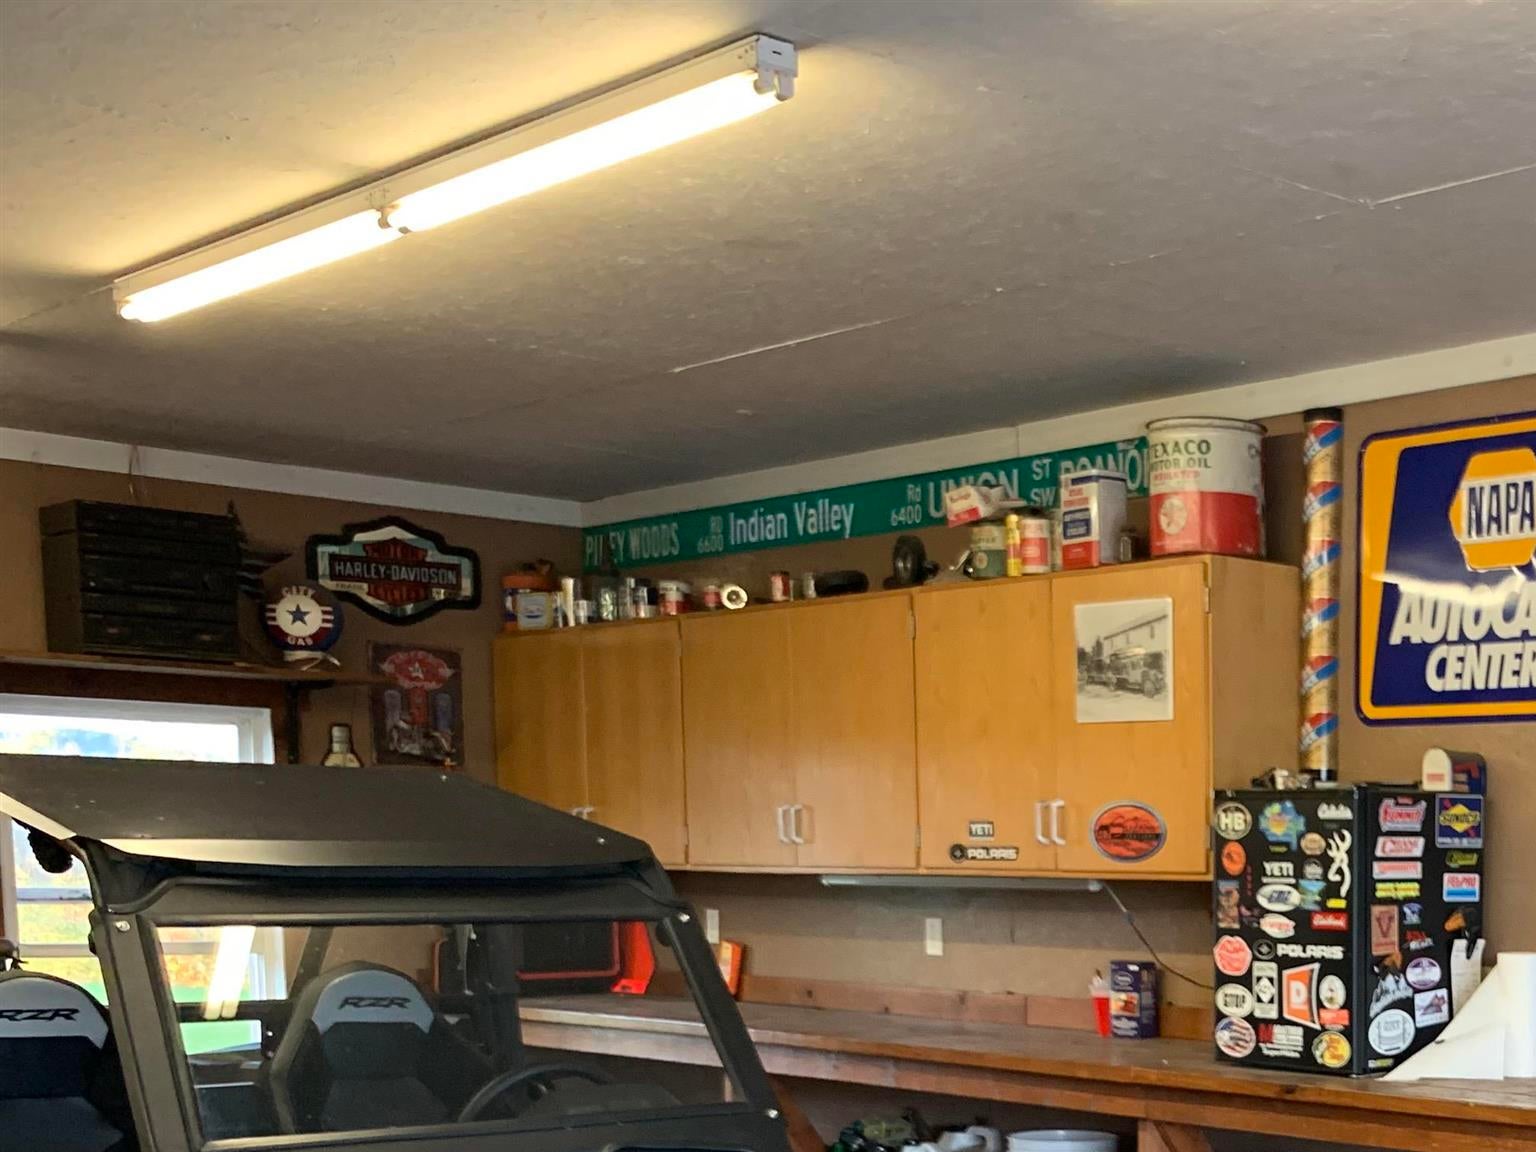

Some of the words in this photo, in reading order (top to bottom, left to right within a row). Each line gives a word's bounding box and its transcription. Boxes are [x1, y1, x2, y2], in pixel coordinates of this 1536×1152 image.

[1032, 459, 1053, 481] ST
[1187, 457, 1212, 469] OIL
[1030, 487, 1057, 506] SW
[729, 507, 789, 546] Indian
[793, 498, 855, 540] Valley
[907, 484, 922, 503] Rd
[890, 504, 922, 526] 6400
[1467, 479, 1536, 539] NAPA
[585, 529, 626, 567] PIEY
[629, 521, 680, 561] WOODS
[335, 560, 457, 585] HARLEY-DAVIDSON
[281, 585, 317, 598] CITY
[287, 636, 313, 646] GAS
[969, 822, 994, 836] YETI
[1219, 811, 1247, 832] HB
[967, 849, 1018, 861] POLARIS
[1263, 861, 1294, 877] YETI
[1276, 942, 1344, 960] POLARIS
[338, 996, 412, 1010] RZR
[0, 1008, 80, 1022] RZR
